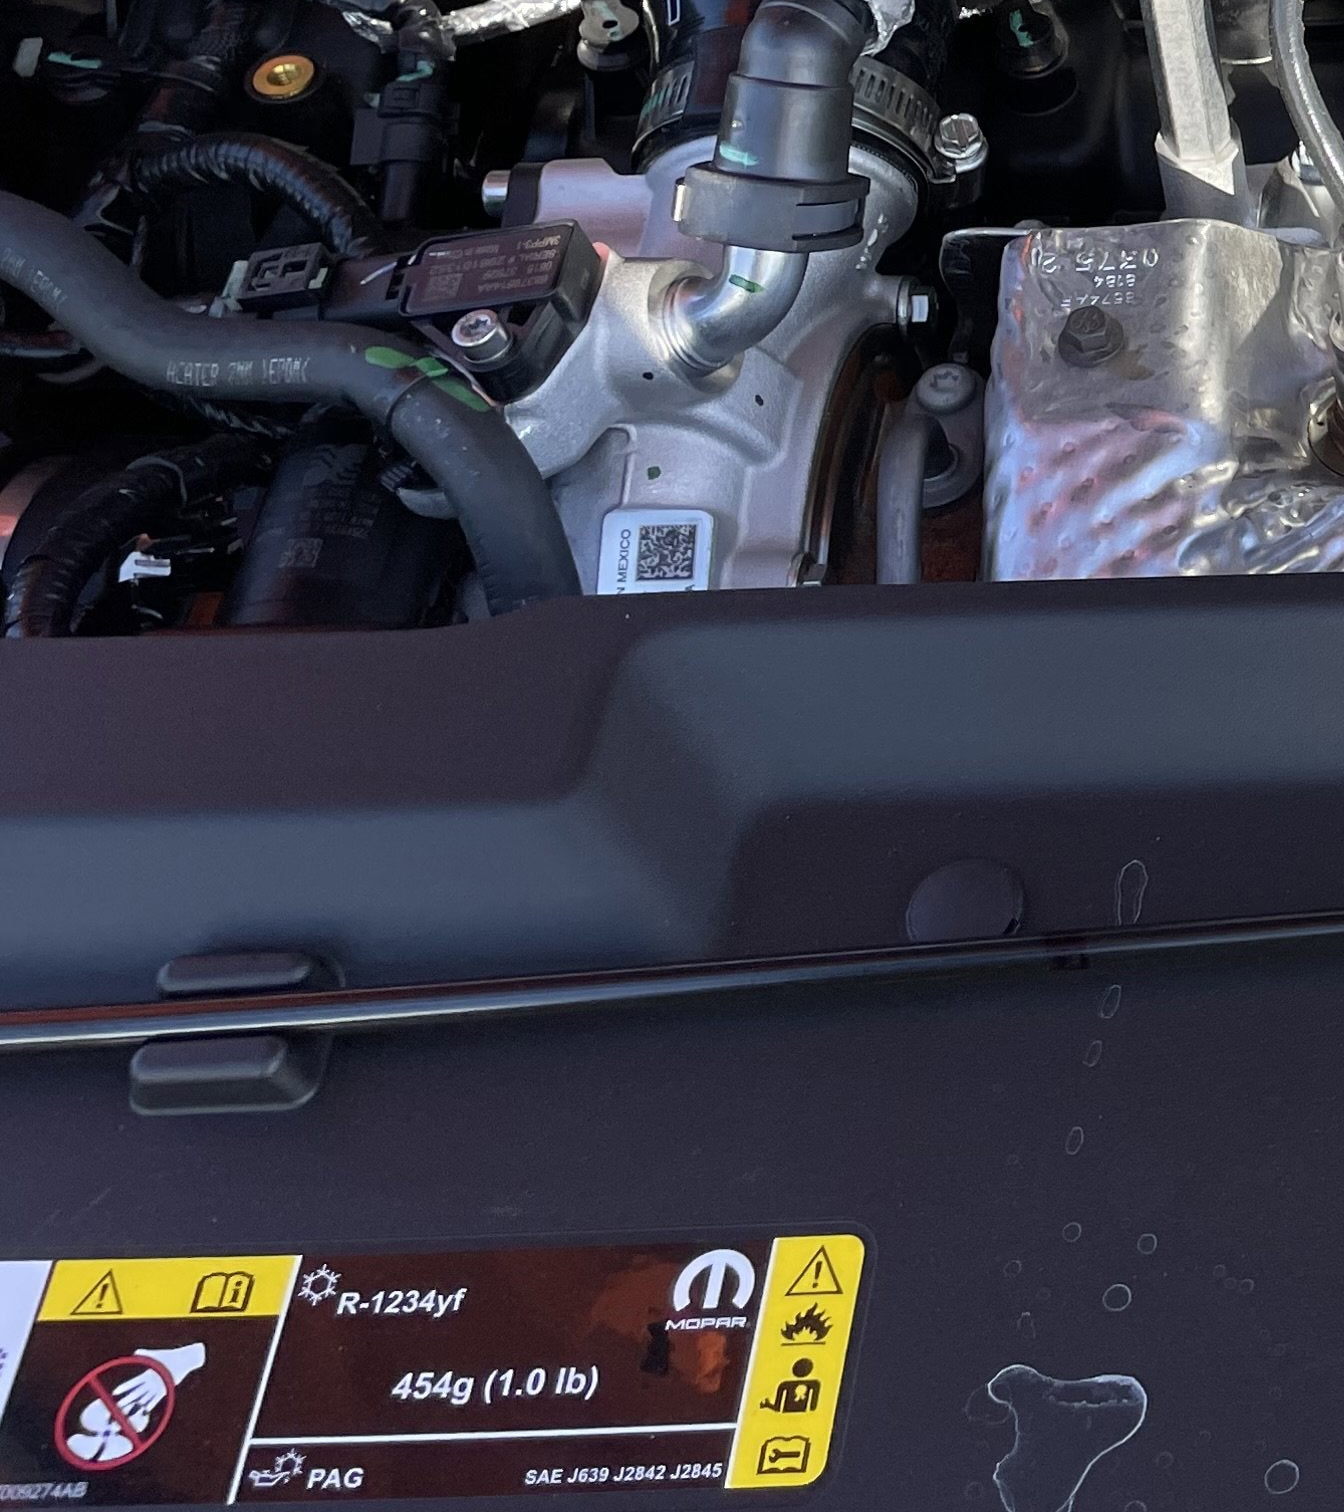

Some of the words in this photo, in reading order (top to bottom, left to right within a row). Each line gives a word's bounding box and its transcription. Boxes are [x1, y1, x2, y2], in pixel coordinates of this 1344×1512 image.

[618, 528, 630, 583] MEXICO
[337, 1289, 467, 1320] R-1234yf
[665, 1316, 747, 1330] MOPAR
[392, 1371, 475, 1405] 454g
[484, 1369, 545, 1404] (1.0
[555, 1366, 599, 1400] lb)
[306, 1467, 364, 1490] PAG
[524, 1469, 563, 1486] SAE
[567, 1466, 609, 1484] J639
[613, 1465, 666, 1482] J2842
[671, 1462, 722, 1480] J2845
